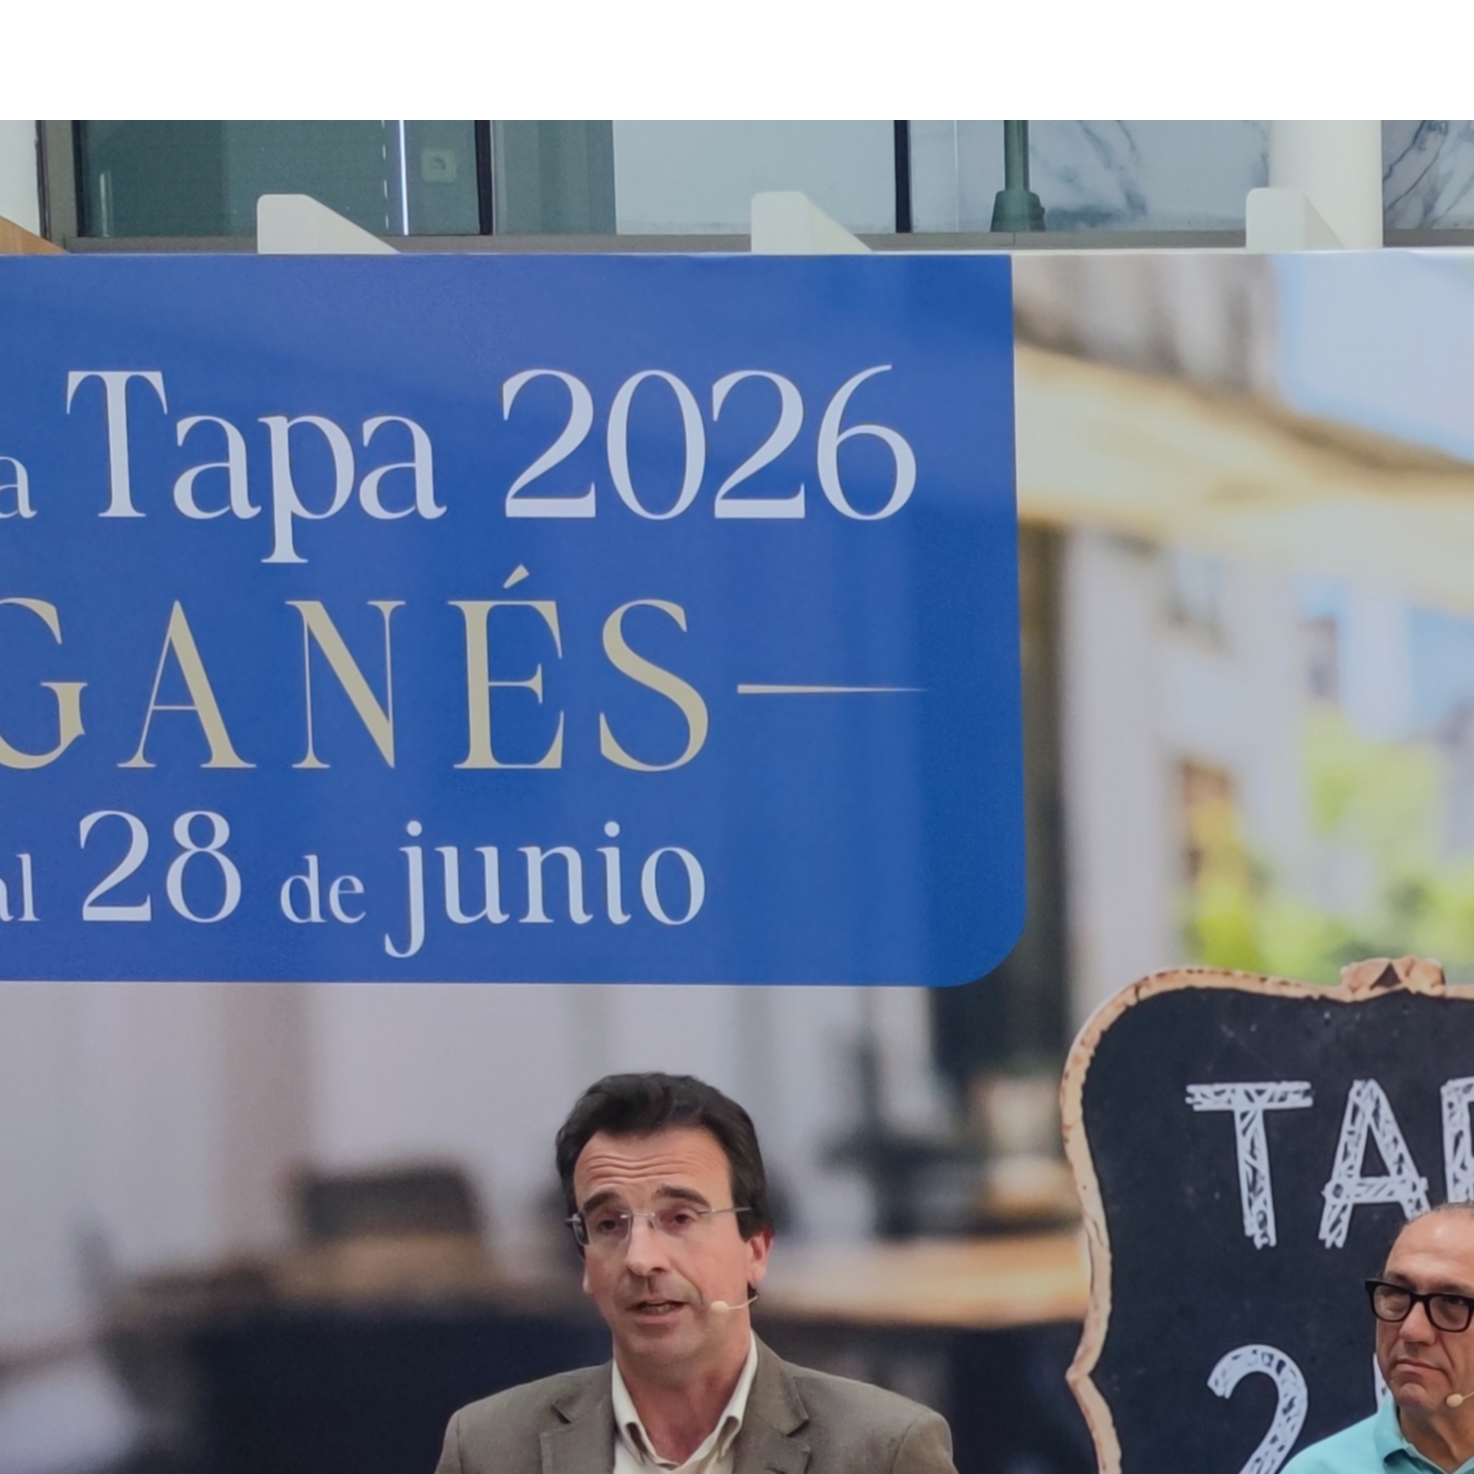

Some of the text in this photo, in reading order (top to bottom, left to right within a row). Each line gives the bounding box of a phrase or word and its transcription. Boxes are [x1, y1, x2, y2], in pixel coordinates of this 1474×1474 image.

[66, 370, 447, 563] Tapa
[502, 364, 917, 520] 2026
[79, 810, 242, 923] 28
[280, 854, 366, 924] de
[384, 820, 706, 959] junio
